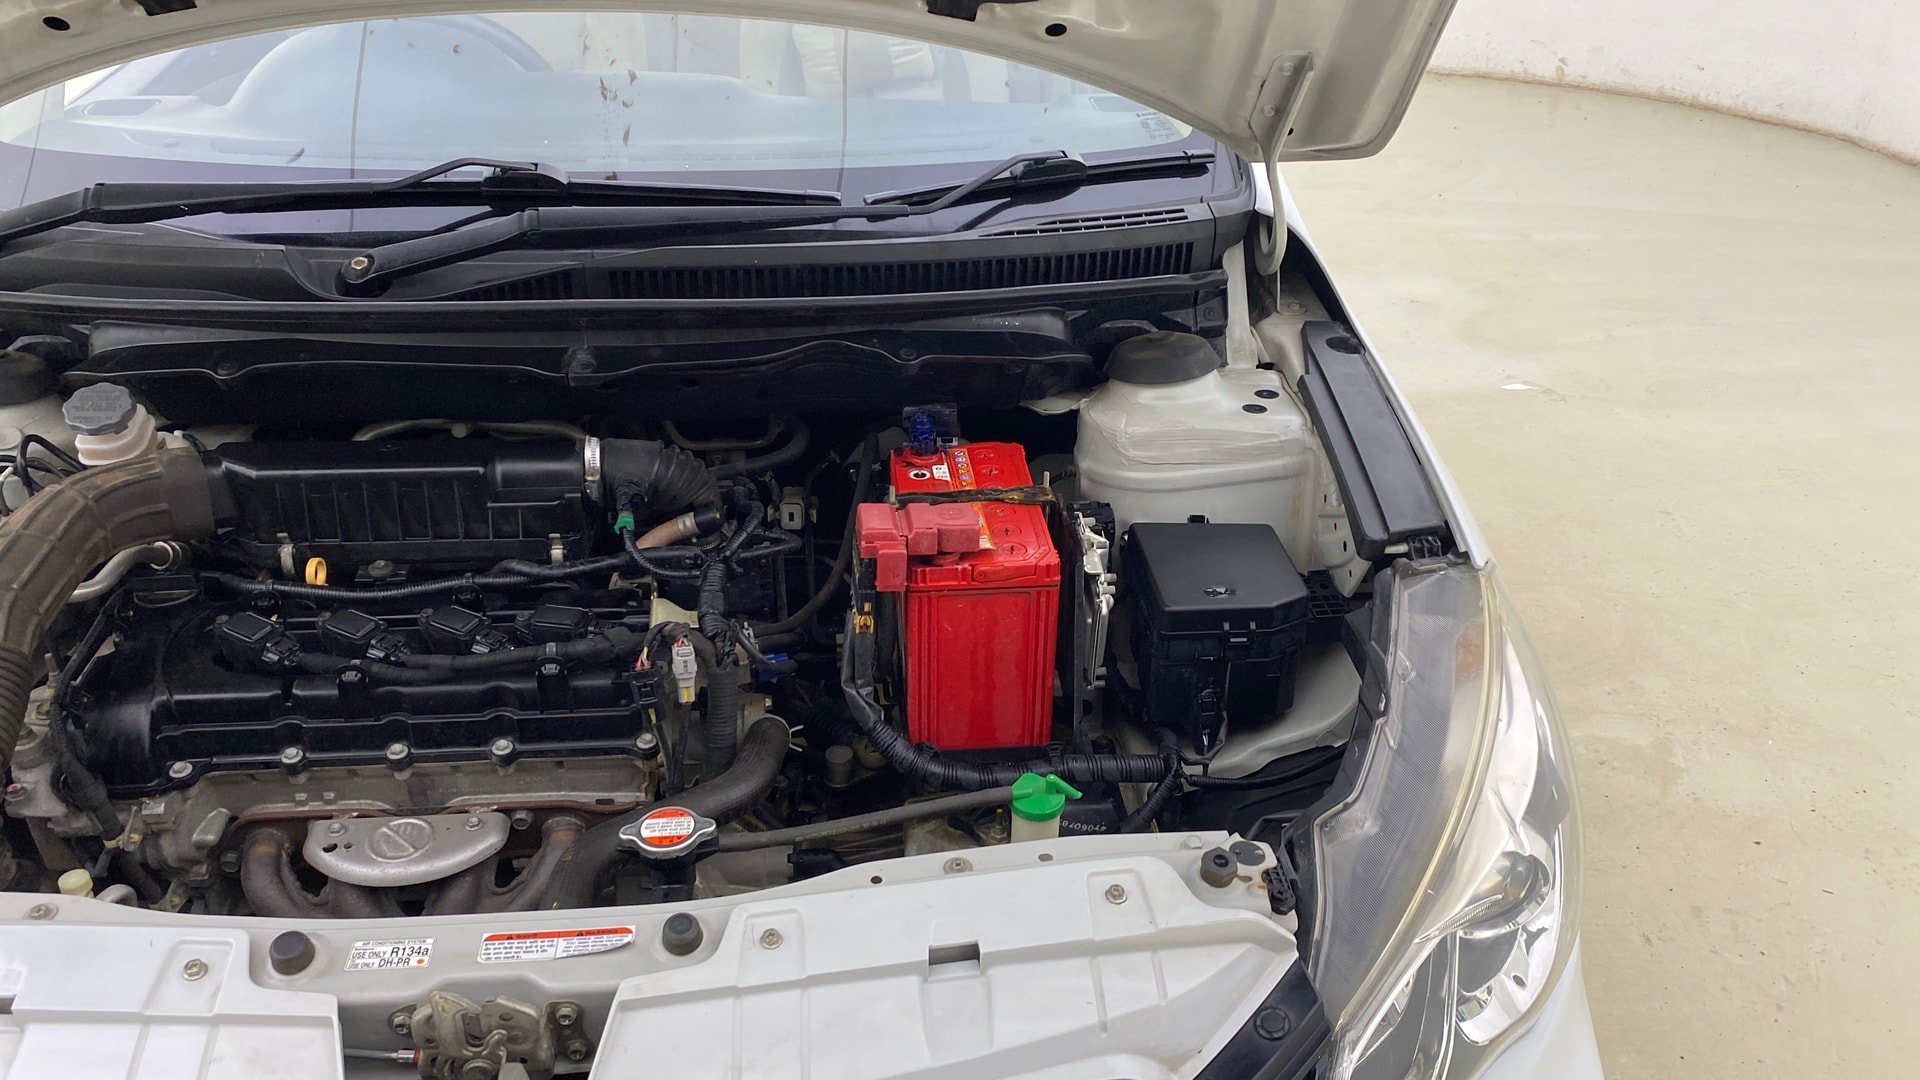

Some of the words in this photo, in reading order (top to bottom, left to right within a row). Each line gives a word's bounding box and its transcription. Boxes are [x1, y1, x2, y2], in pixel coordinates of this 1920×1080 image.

[352, 951, 366, 959] USE
[368, 950, 387, 959] ONLY
[390, 946, 430, 957] R134a
[378, 957, 411, 968] DH-PR
